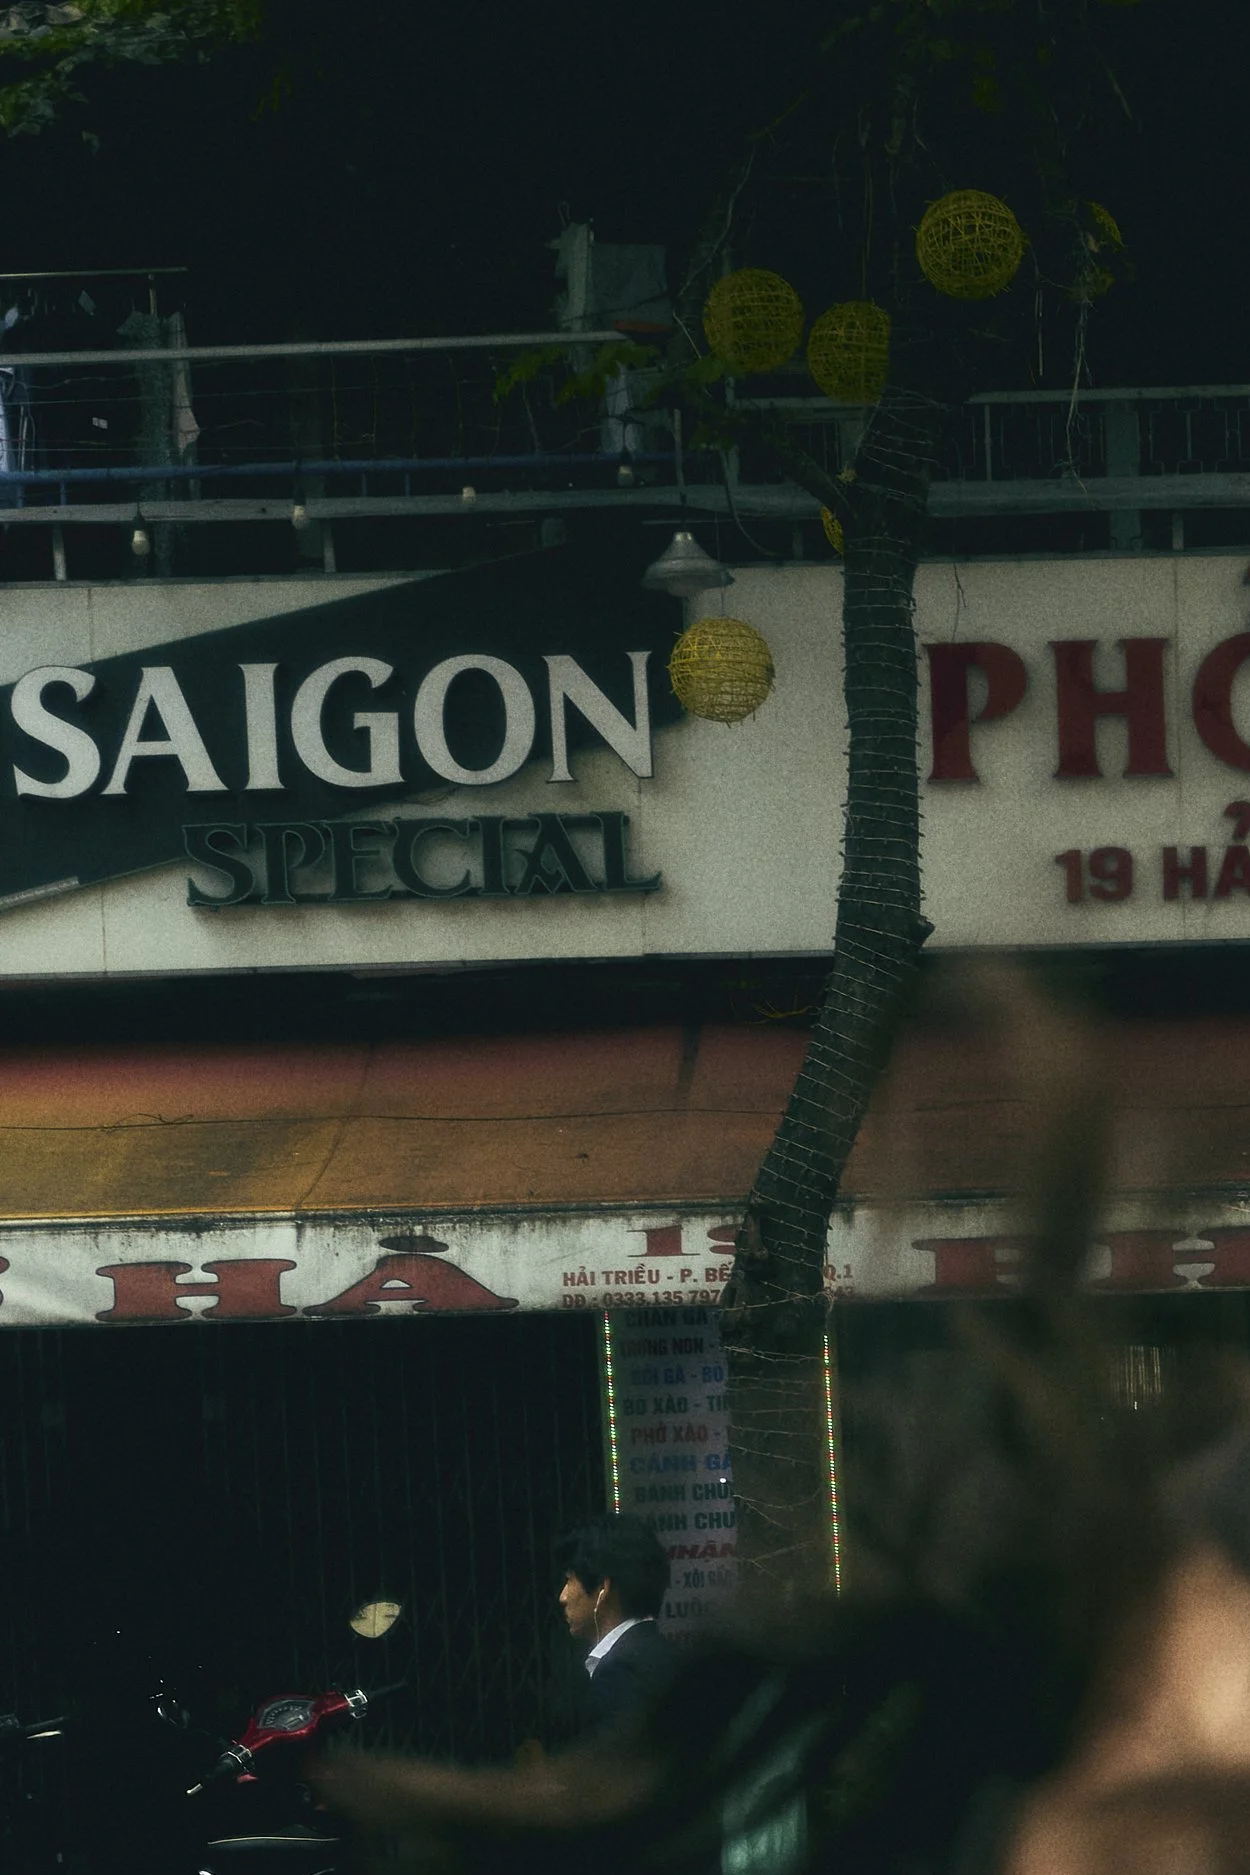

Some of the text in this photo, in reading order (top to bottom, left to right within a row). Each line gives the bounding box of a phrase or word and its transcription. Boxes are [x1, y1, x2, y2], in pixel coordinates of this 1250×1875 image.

[10, 651, 654, 800] SAIGON
[181, 810, 662, 908] SPECIAL
[1055, 846, 1134, 902] 19
[96, 1236, 518, 1321] HÀ
[563, 1266, 596, 1287] HẢI
[602, 1263, 660, 1286] TRIỀU
[680, 1269, 698, 1283] P.
[705, 1261, 734, 1283] BẾ
[653, 1393, 688, 1415] XÀO
[673, 1421, 708, 1444] XÀO
